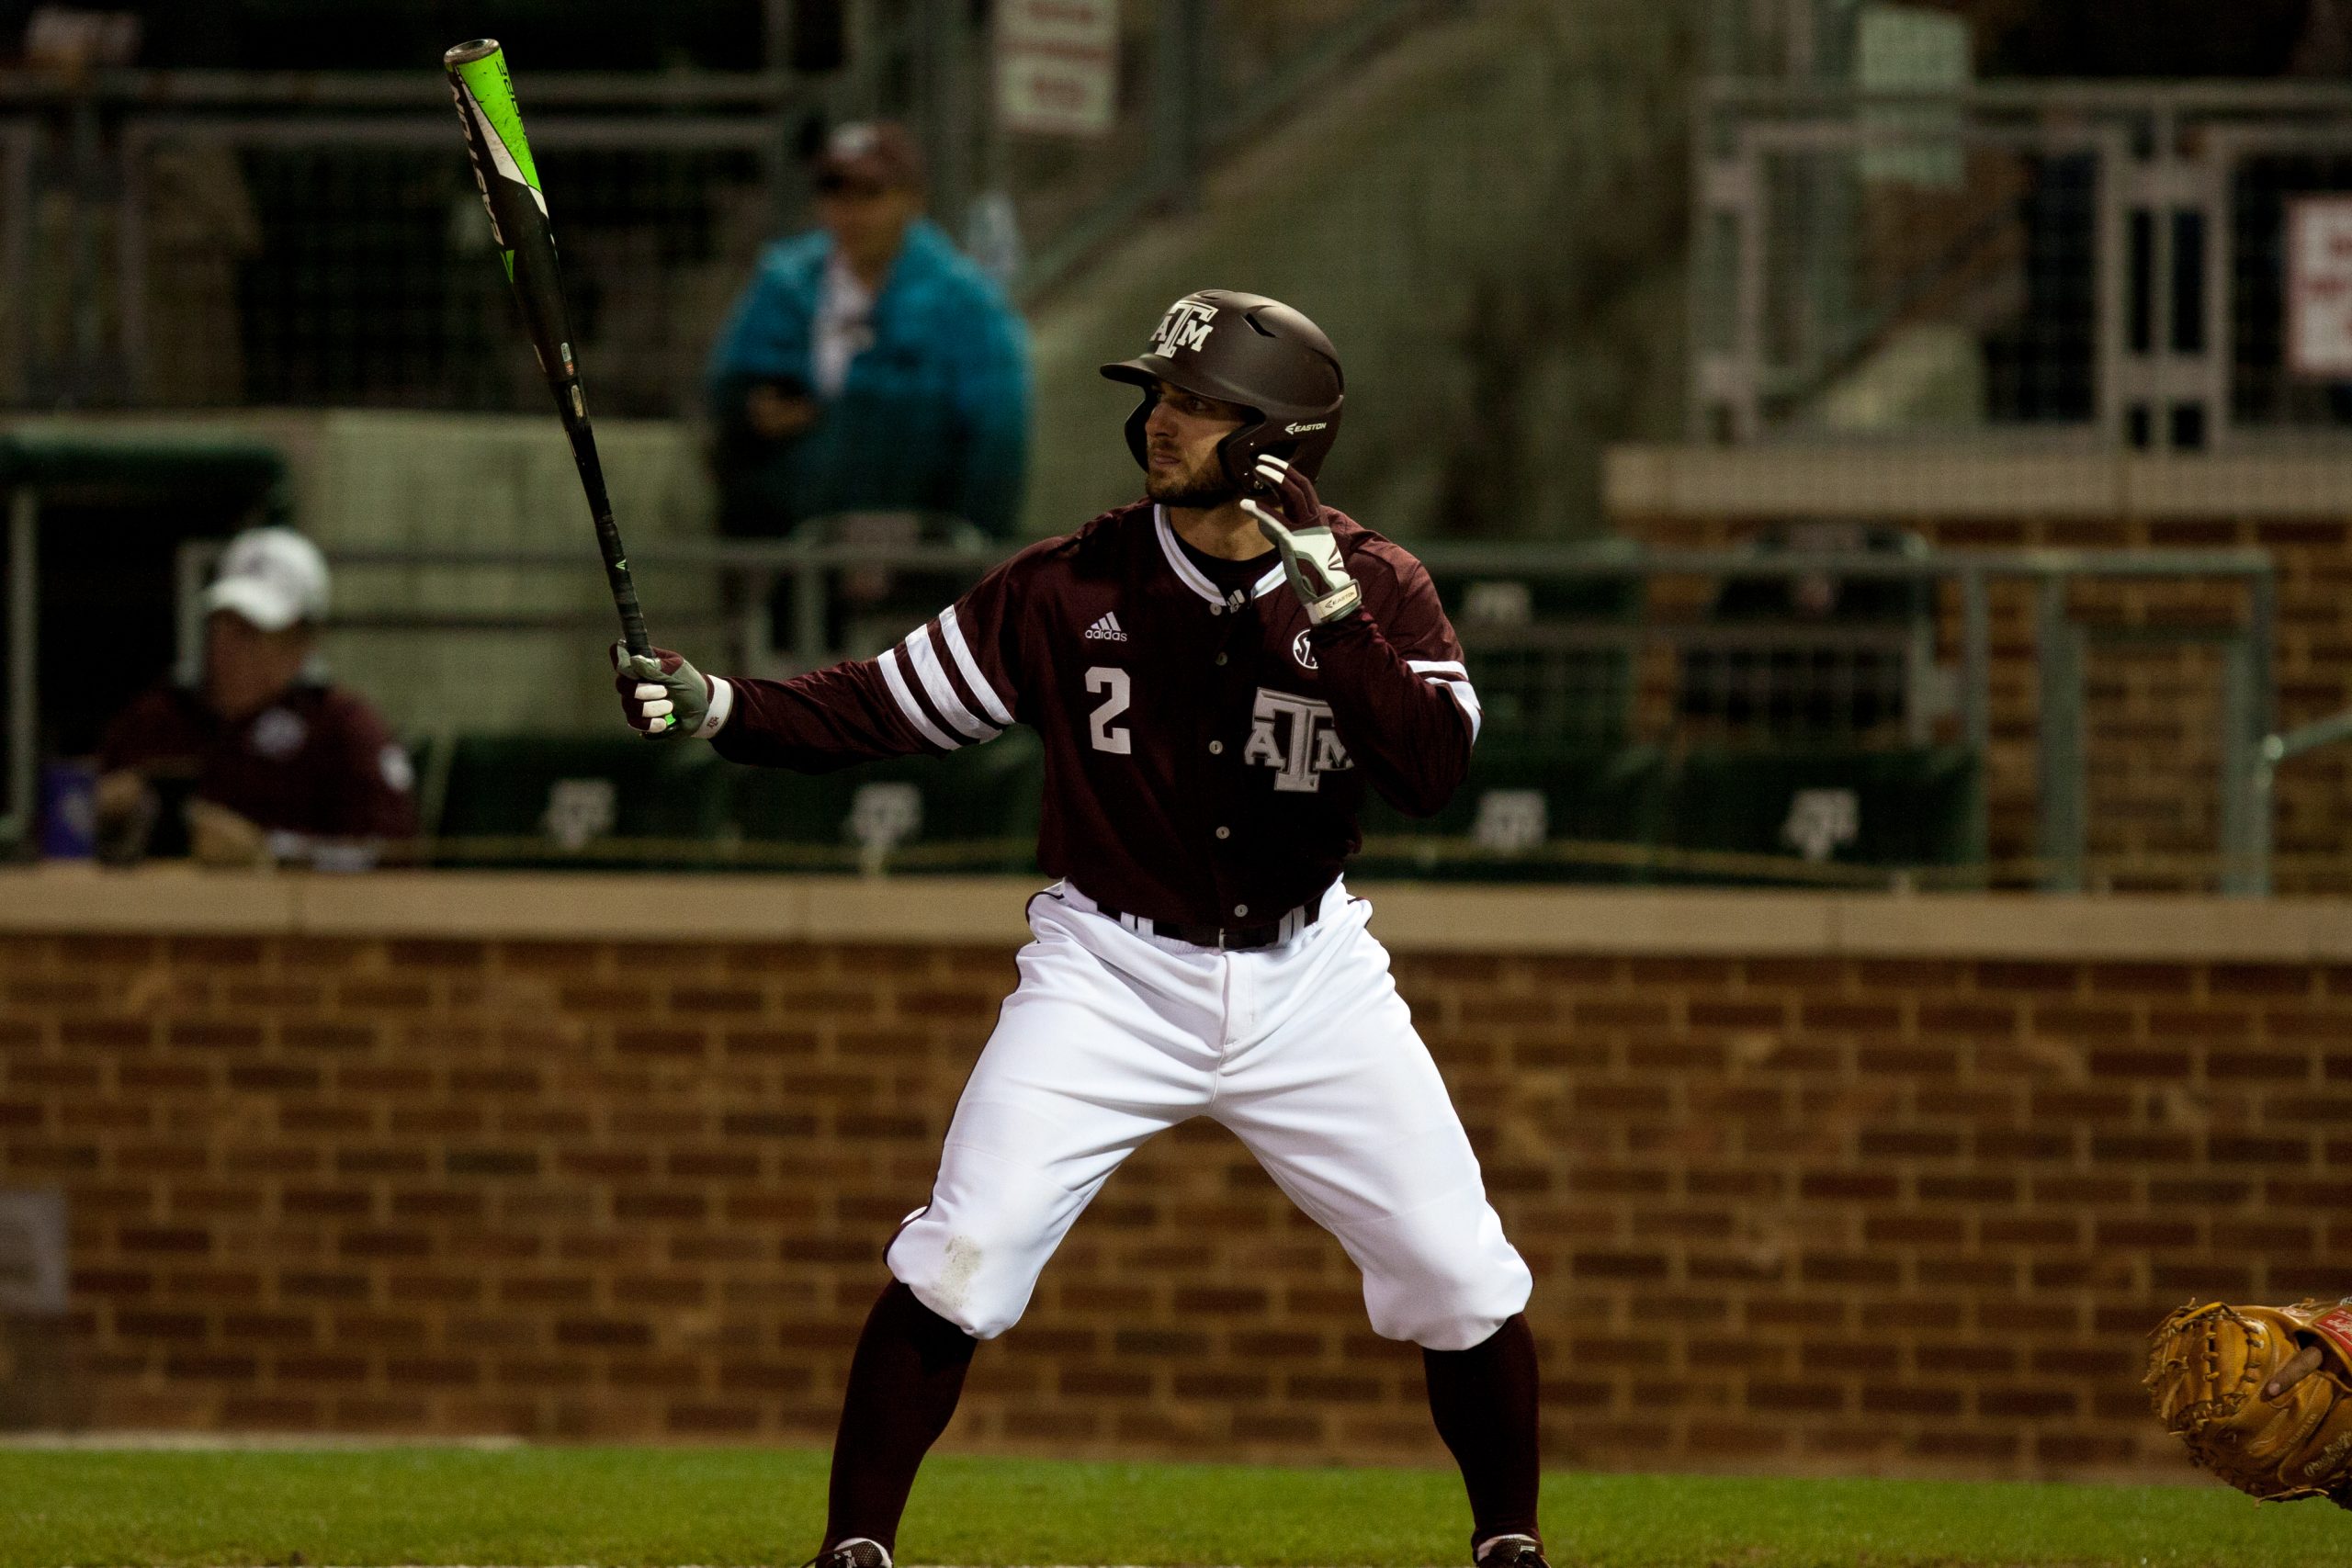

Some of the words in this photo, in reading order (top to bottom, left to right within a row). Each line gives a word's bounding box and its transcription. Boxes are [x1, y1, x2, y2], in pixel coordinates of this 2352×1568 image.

[1295, 422, 1327, 433] EASTON
[1084, 626, 1128, 643] adidas
[1084, 666, 1132, 755] 2
